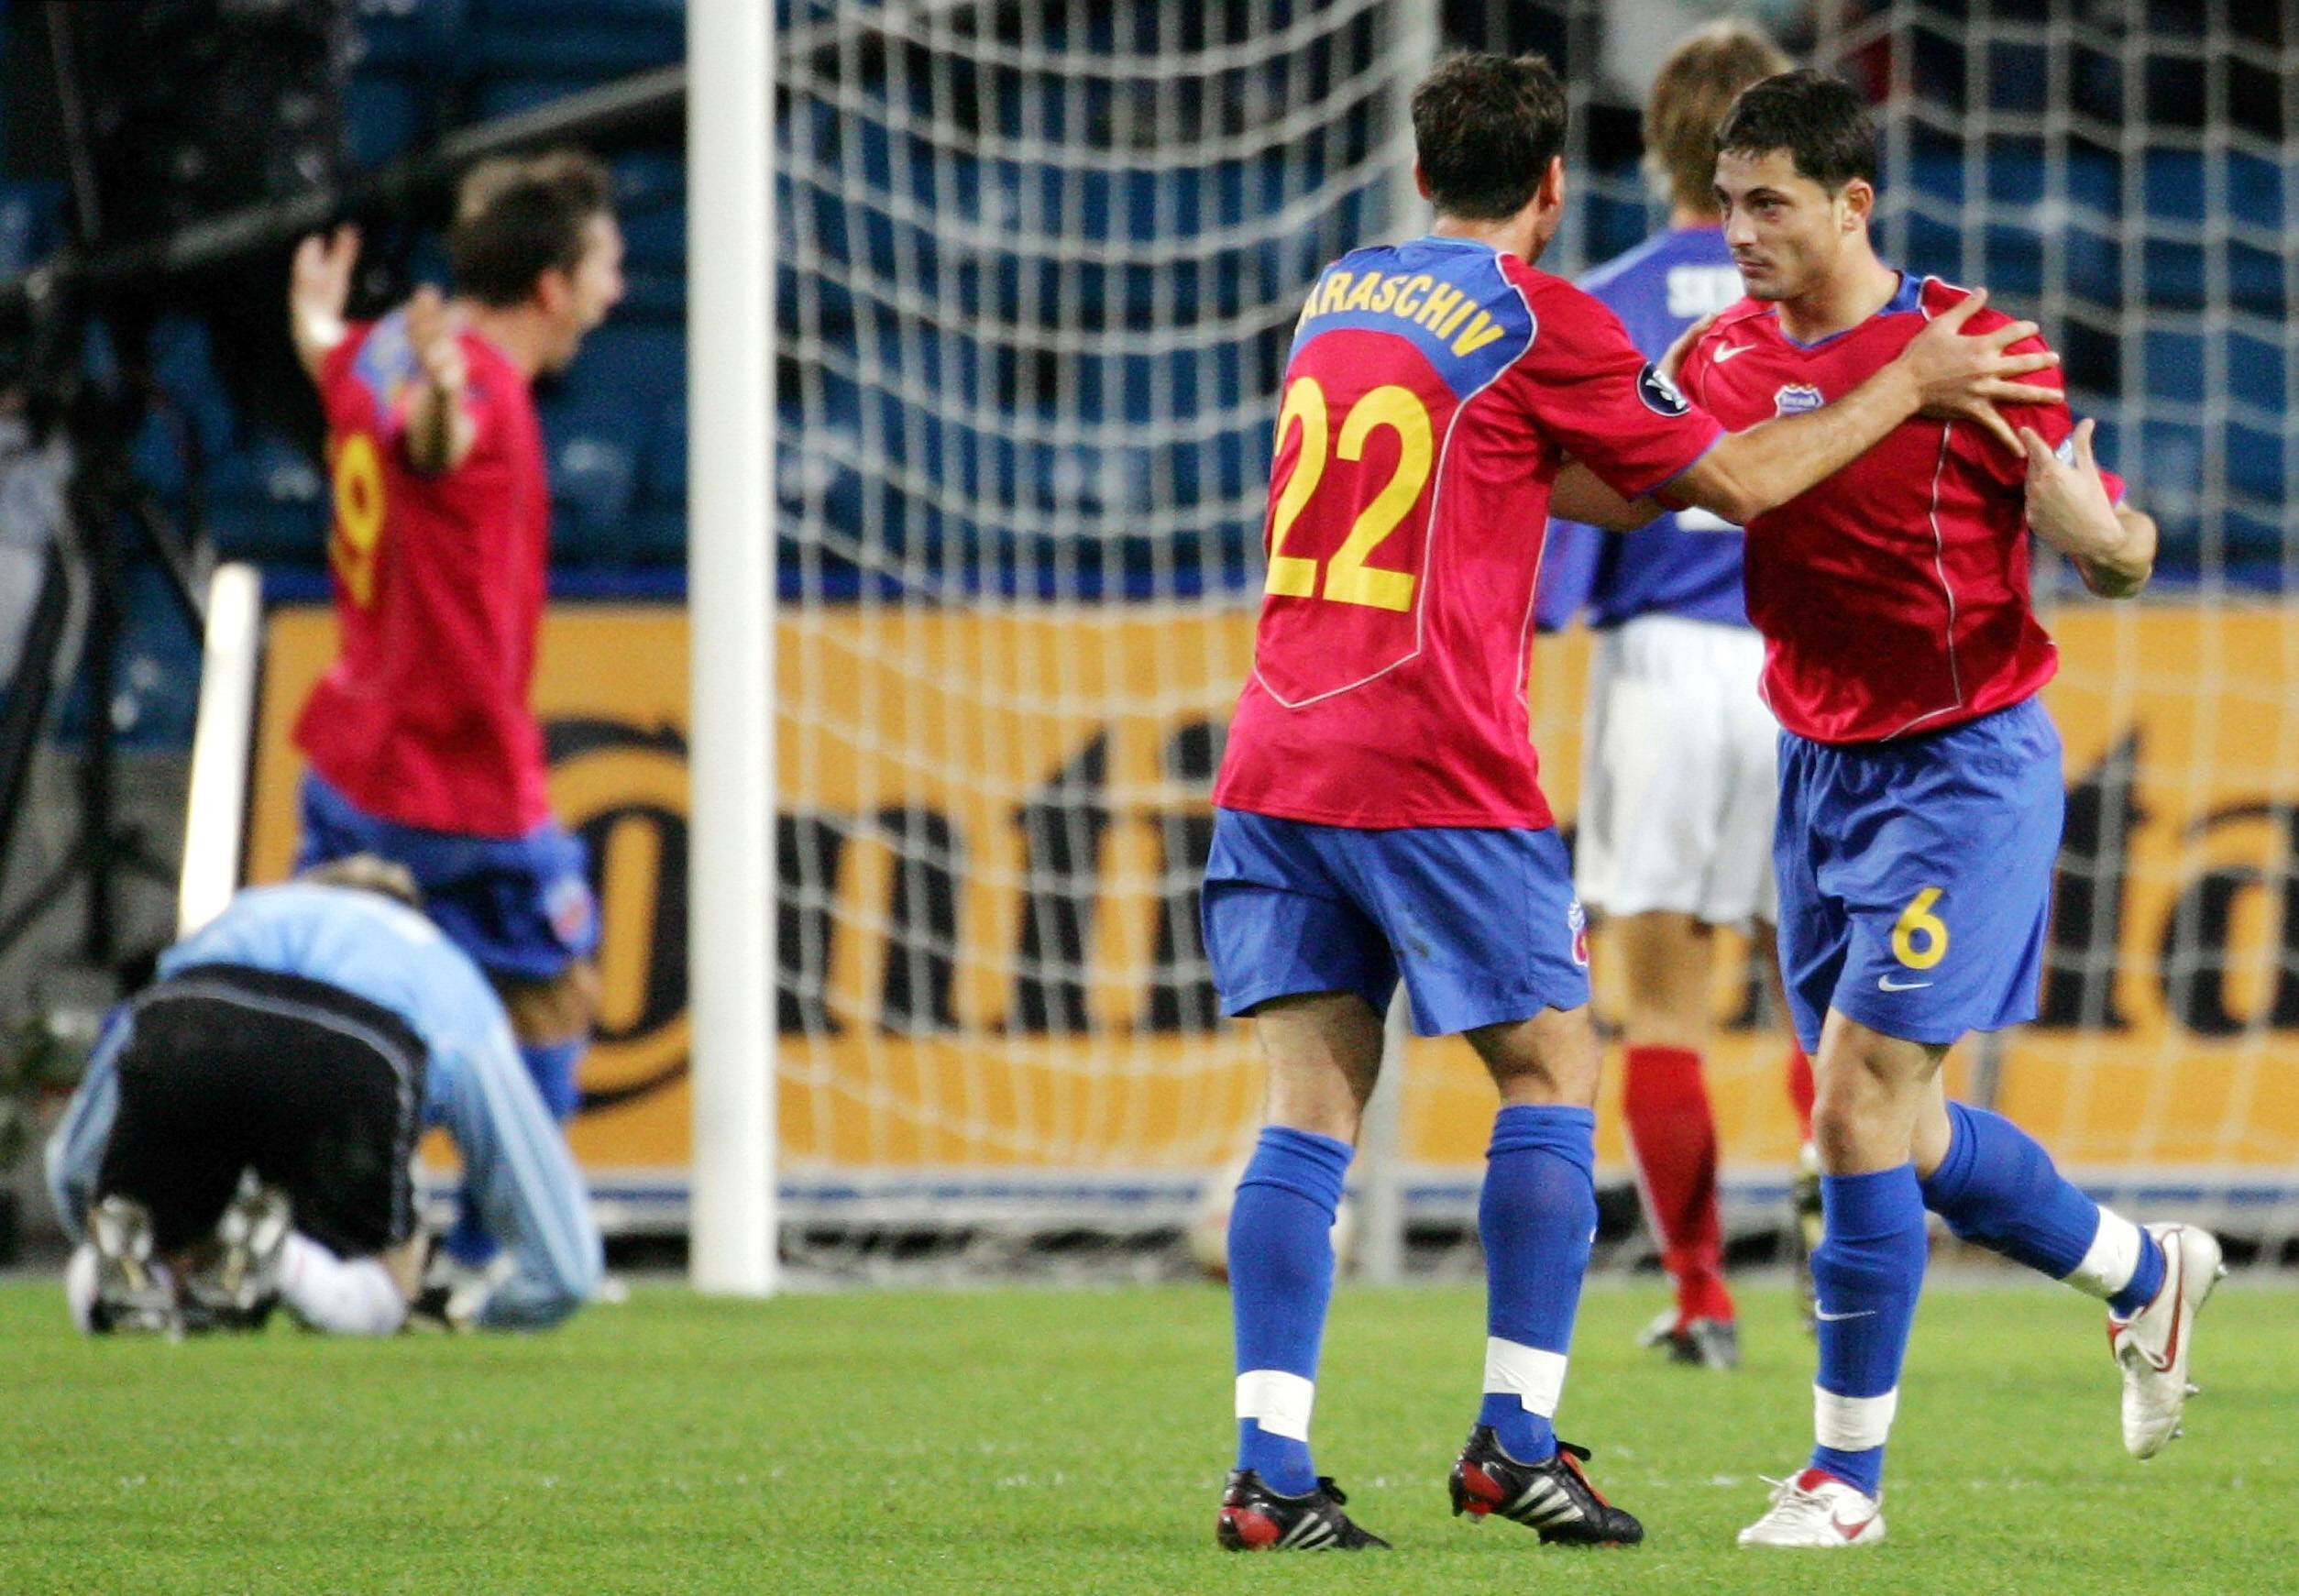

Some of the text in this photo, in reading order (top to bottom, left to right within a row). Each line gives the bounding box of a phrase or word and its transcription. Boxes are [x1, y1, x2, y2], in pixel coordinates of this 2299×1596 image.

[1293, 271, 1505, 357] ARASCHIV
[1264, 377, 1433, 611] 22
[1889, 886, 1949, 970] 6
